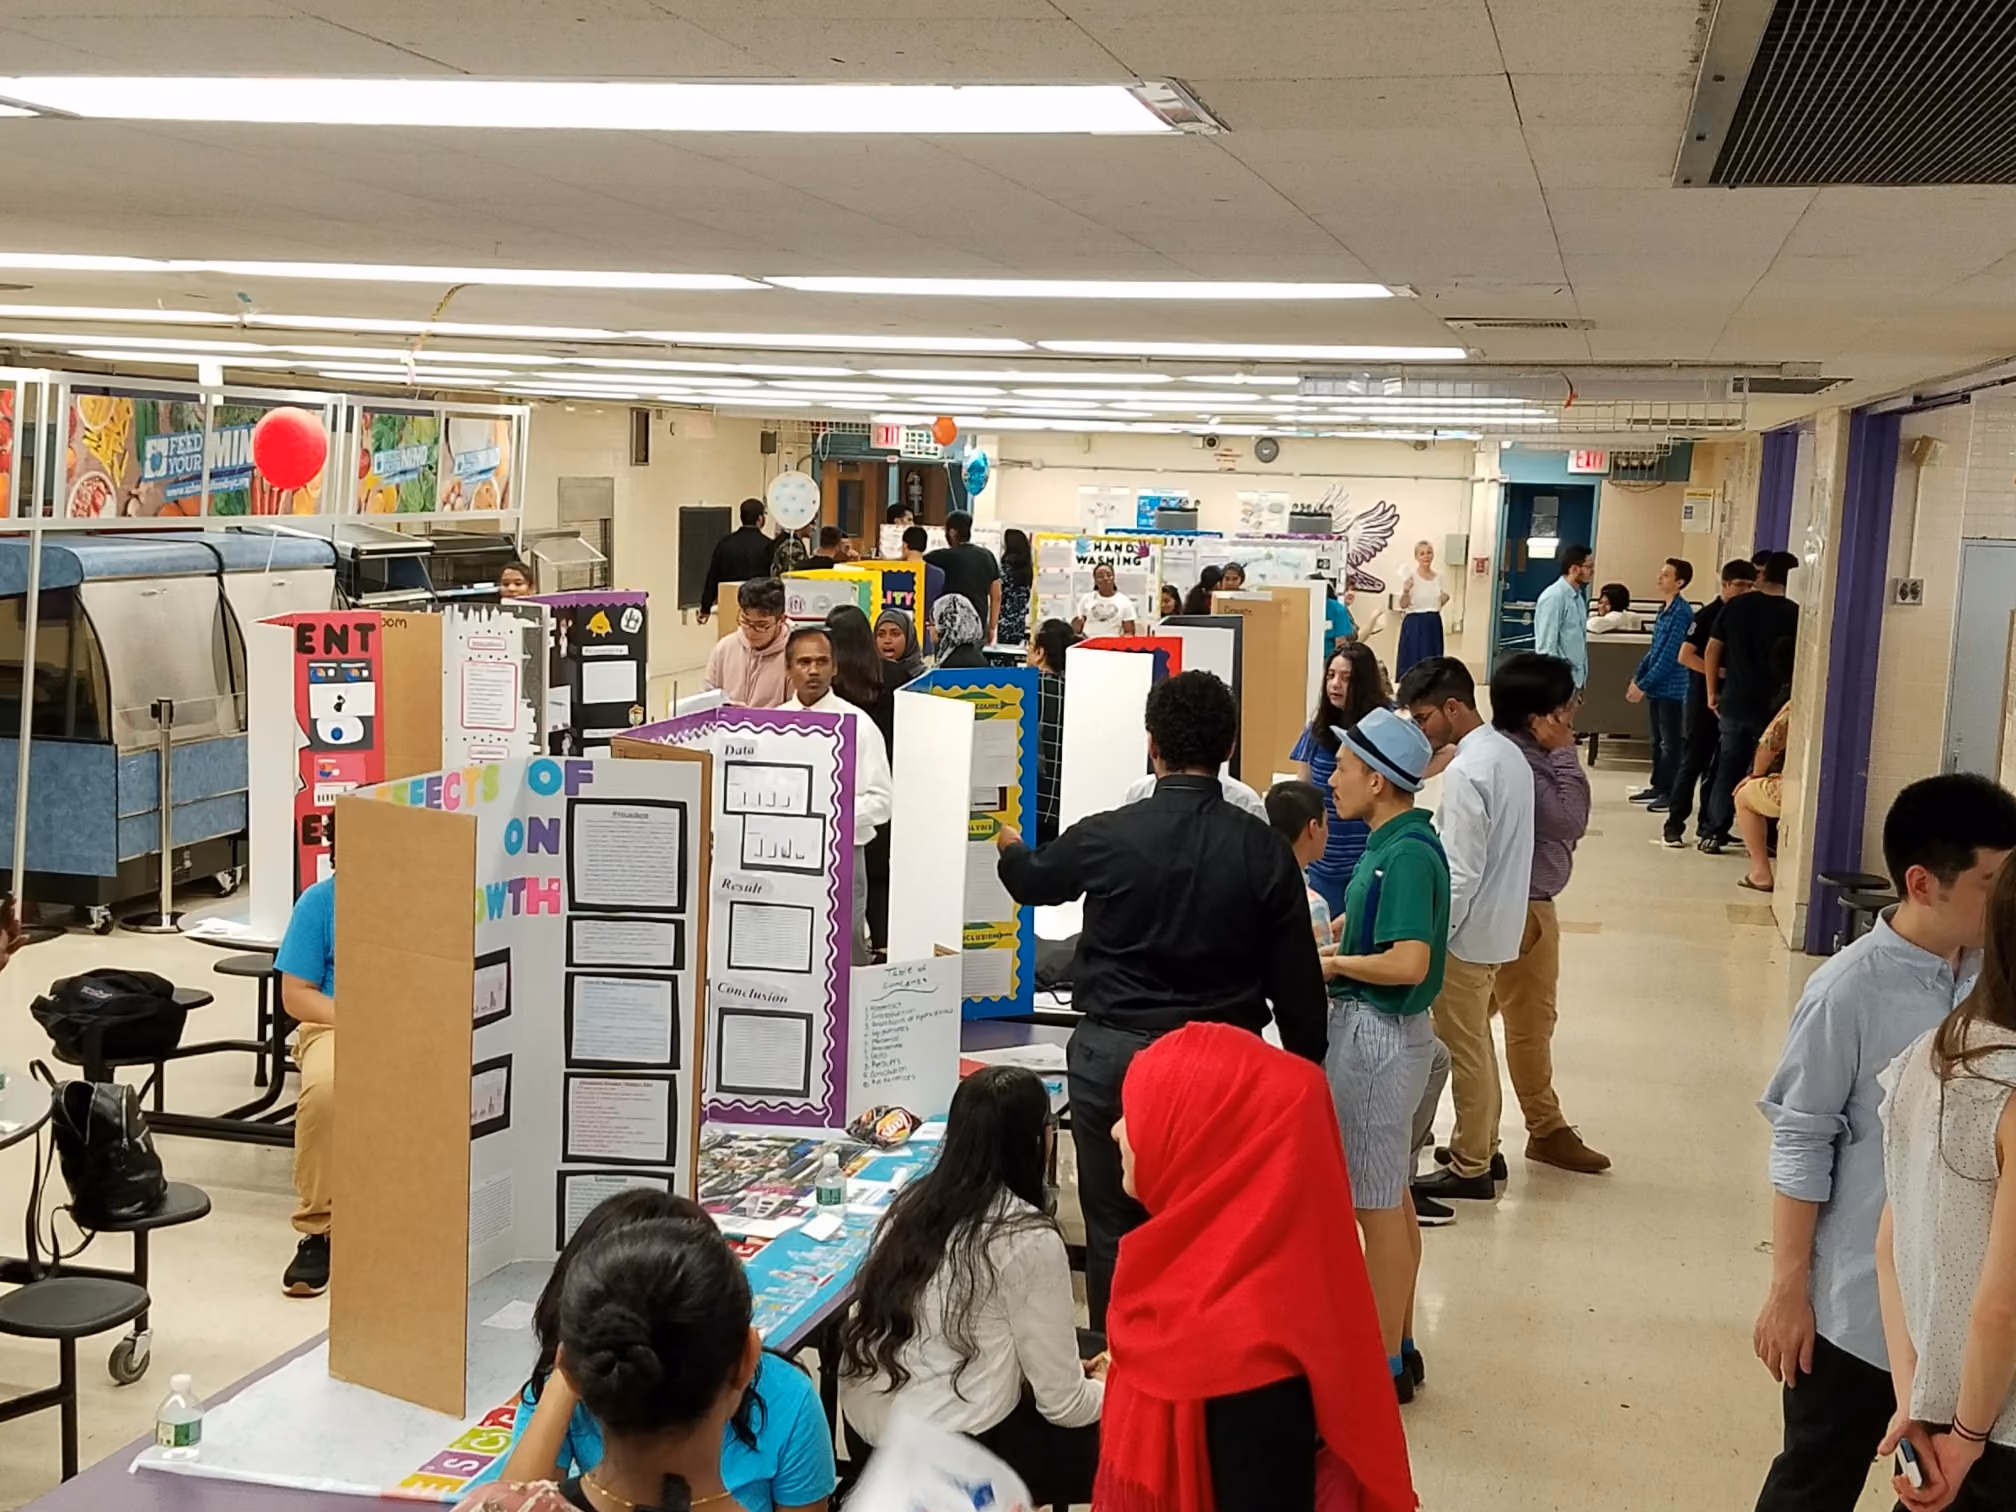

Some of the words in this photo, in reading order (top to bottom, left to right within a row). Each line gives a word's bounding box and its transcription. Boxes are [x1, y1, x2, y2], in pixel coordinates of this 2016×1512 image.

[169, 433, 203, 456] FEED
[208, 428, 256, 469] MIN
[168, 453, 203, 475] YOUR
[1093, 542, 1134, 553] HAND
[1163, 537, 1195, 548] ITY
[1075, 555, 1142, 566] WASHING
[881, 590, 914, 605] ITY
[296, 623, 377, 655] ENT
[725, 744, 755, 756] Data
[527, 758, 594, 796] OF
[504, 816, 561, 856] ON
[721, 878, 763, 895] Result
[717, 982, 789, 1004] Conclusion
